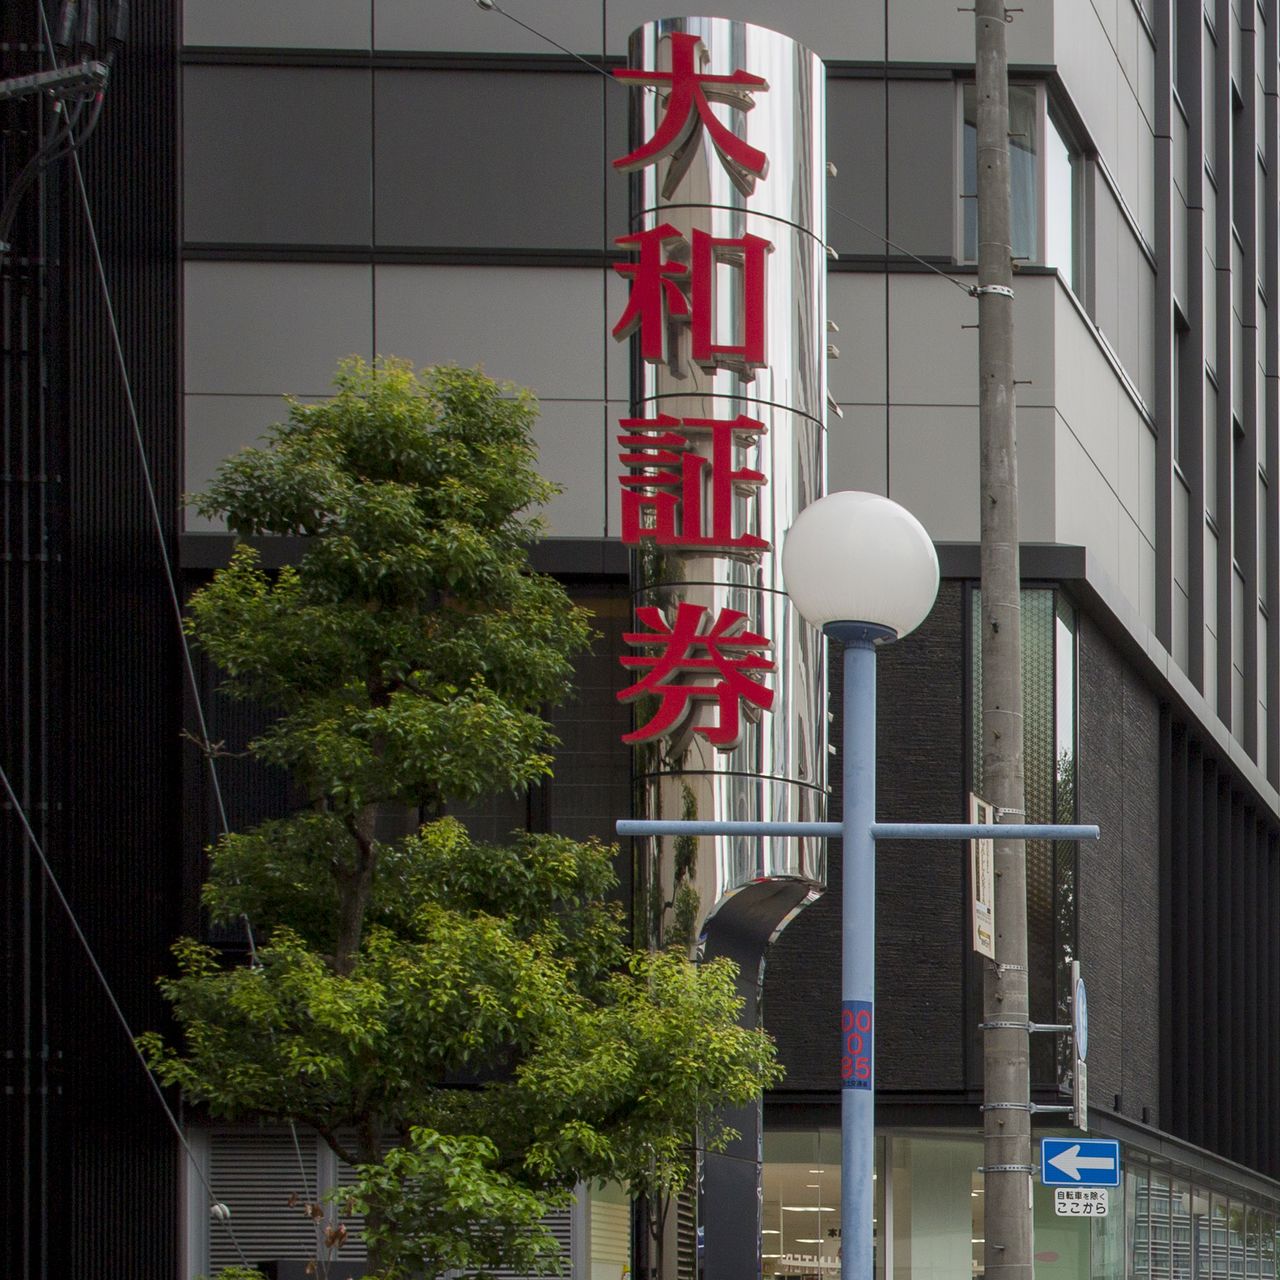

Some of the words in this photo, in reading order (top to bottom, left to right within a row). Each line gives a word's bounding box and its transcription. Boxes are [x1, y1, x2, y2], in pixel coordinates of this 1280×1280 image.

[612, 33, 776, 748] 大和証券
[1057, 1191, 1105, 1201] 自転車を除く
[1057, 1202, 1107, 1215] ここから
